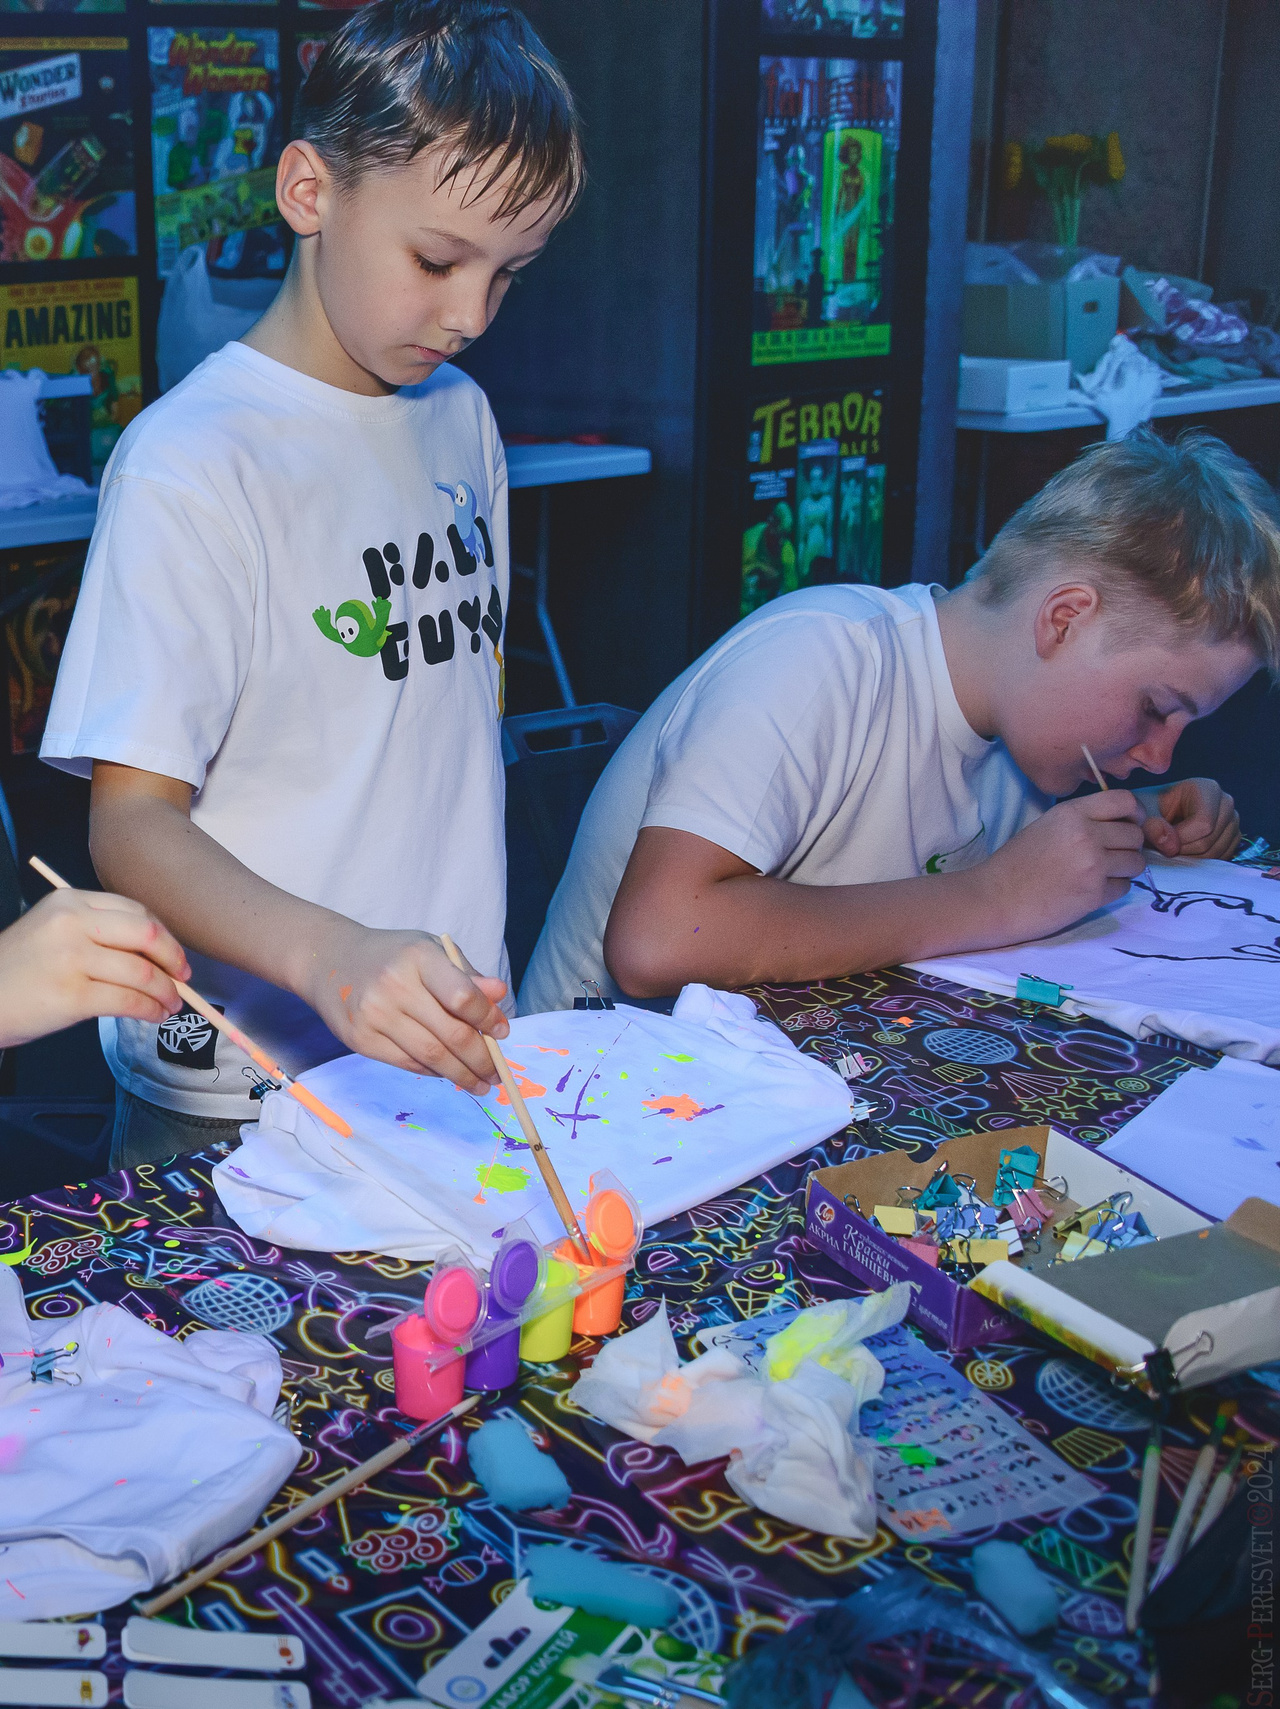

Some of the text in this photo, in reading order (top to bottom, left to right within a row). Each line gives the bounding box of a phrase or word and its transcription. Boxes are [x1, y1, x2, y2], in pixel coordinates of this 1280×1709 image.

[5, 300, 132, 349] AMAZING
[752, 391, 883, 465] TERROR
[808, 1222, 900, 1287] АКРИЛ ГЛЯНЦЕВЫ
[842, 1223, 891, 1271] Краски
